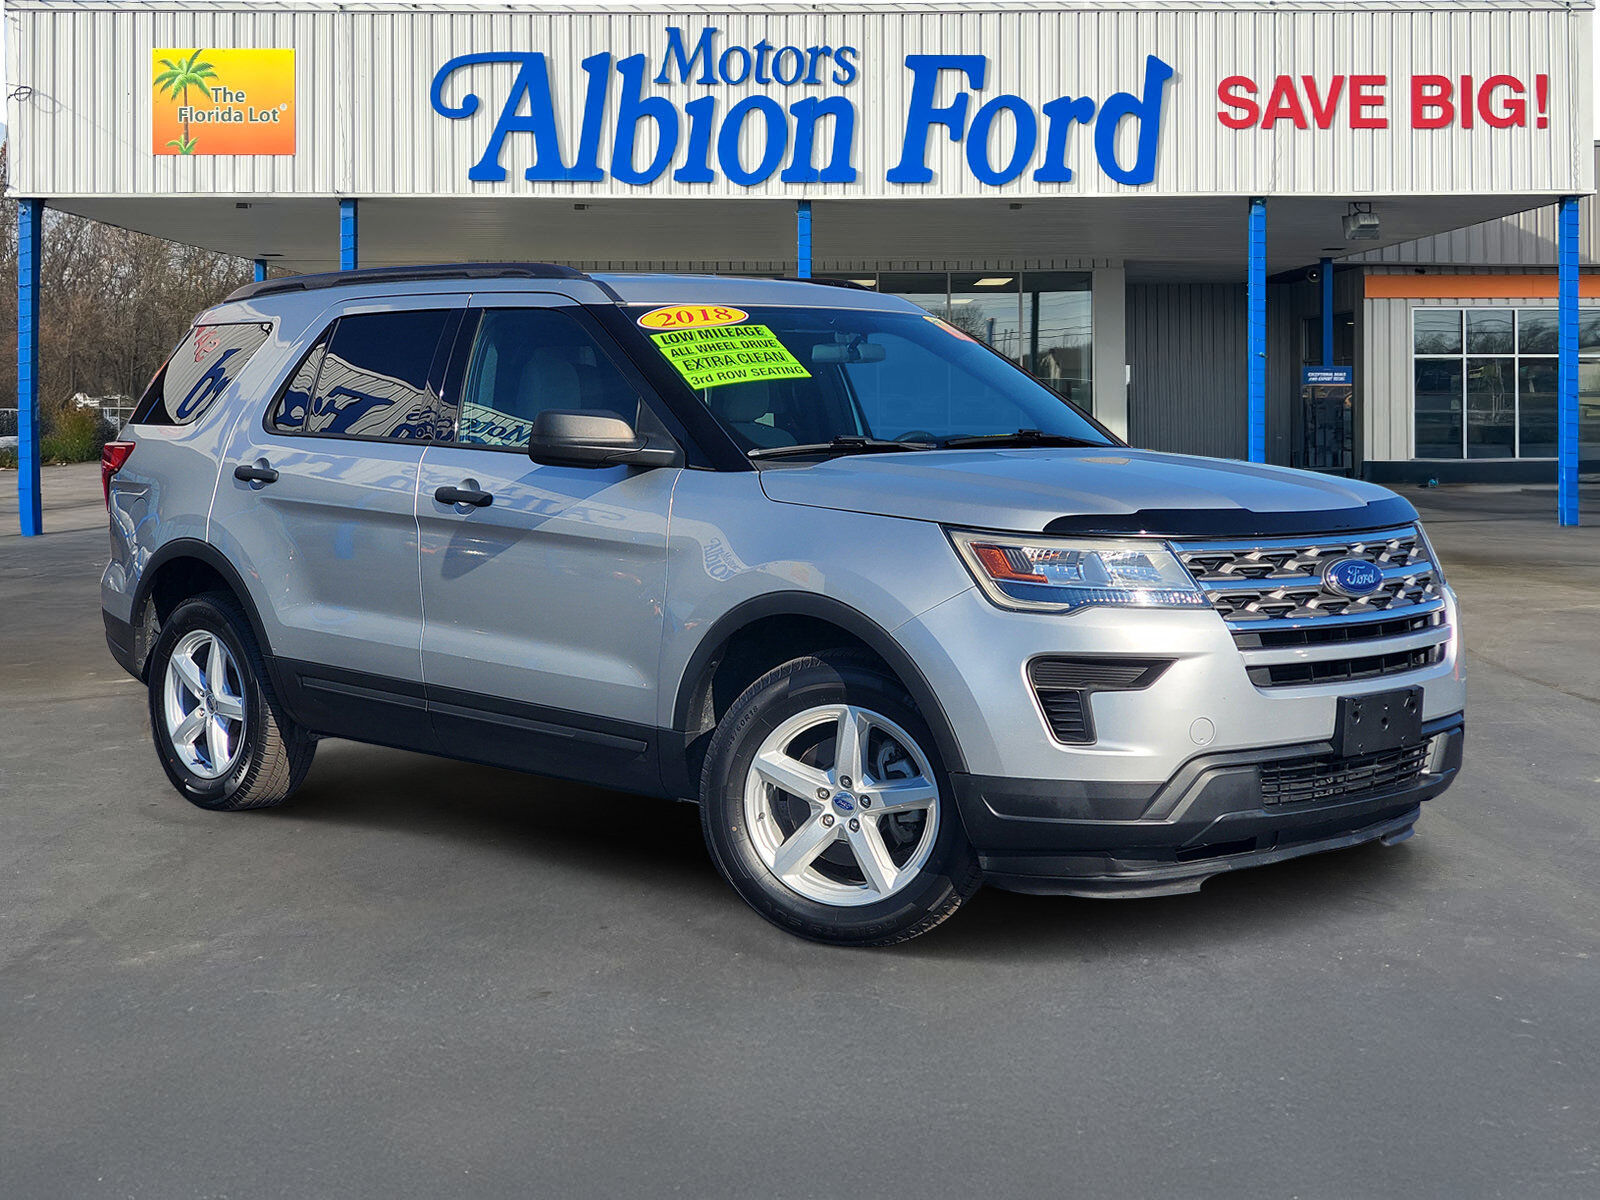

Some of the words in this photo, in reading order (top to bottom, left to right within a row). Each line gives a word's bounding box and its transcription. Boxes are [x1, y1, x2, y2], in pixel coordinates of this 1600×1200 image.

[653, 27, 858, 86] Motors
[211, 87, 246, 103] The
[1217, 74, 1388, 129] SAVE
[1411, 73, 1548, 129] BIG!
[178, 107, 243, 122] Florida
[430, 51, 857, 186] Albion
[886, 54, 1174, 186] Ford
[655, 307, 733, 327] 2018
[659, 331, 696, 345] LOW
[699, 326, 764, 340] MILEAGE
[670, 347, 695, 358] ALL
[696, 342, 739, 354] WHEEL
[742, 339, 777, 350] DRIVE
[683, 355, 738, 371] EXTRA
[739, 350, 784, 365] CLEAN
[690, 371, 714, 385] 3rd
[716, 368, 747, 380] ROW
[751, 366, 804, 377] SEATING
[1347, 565, 1376, 585] Ford
